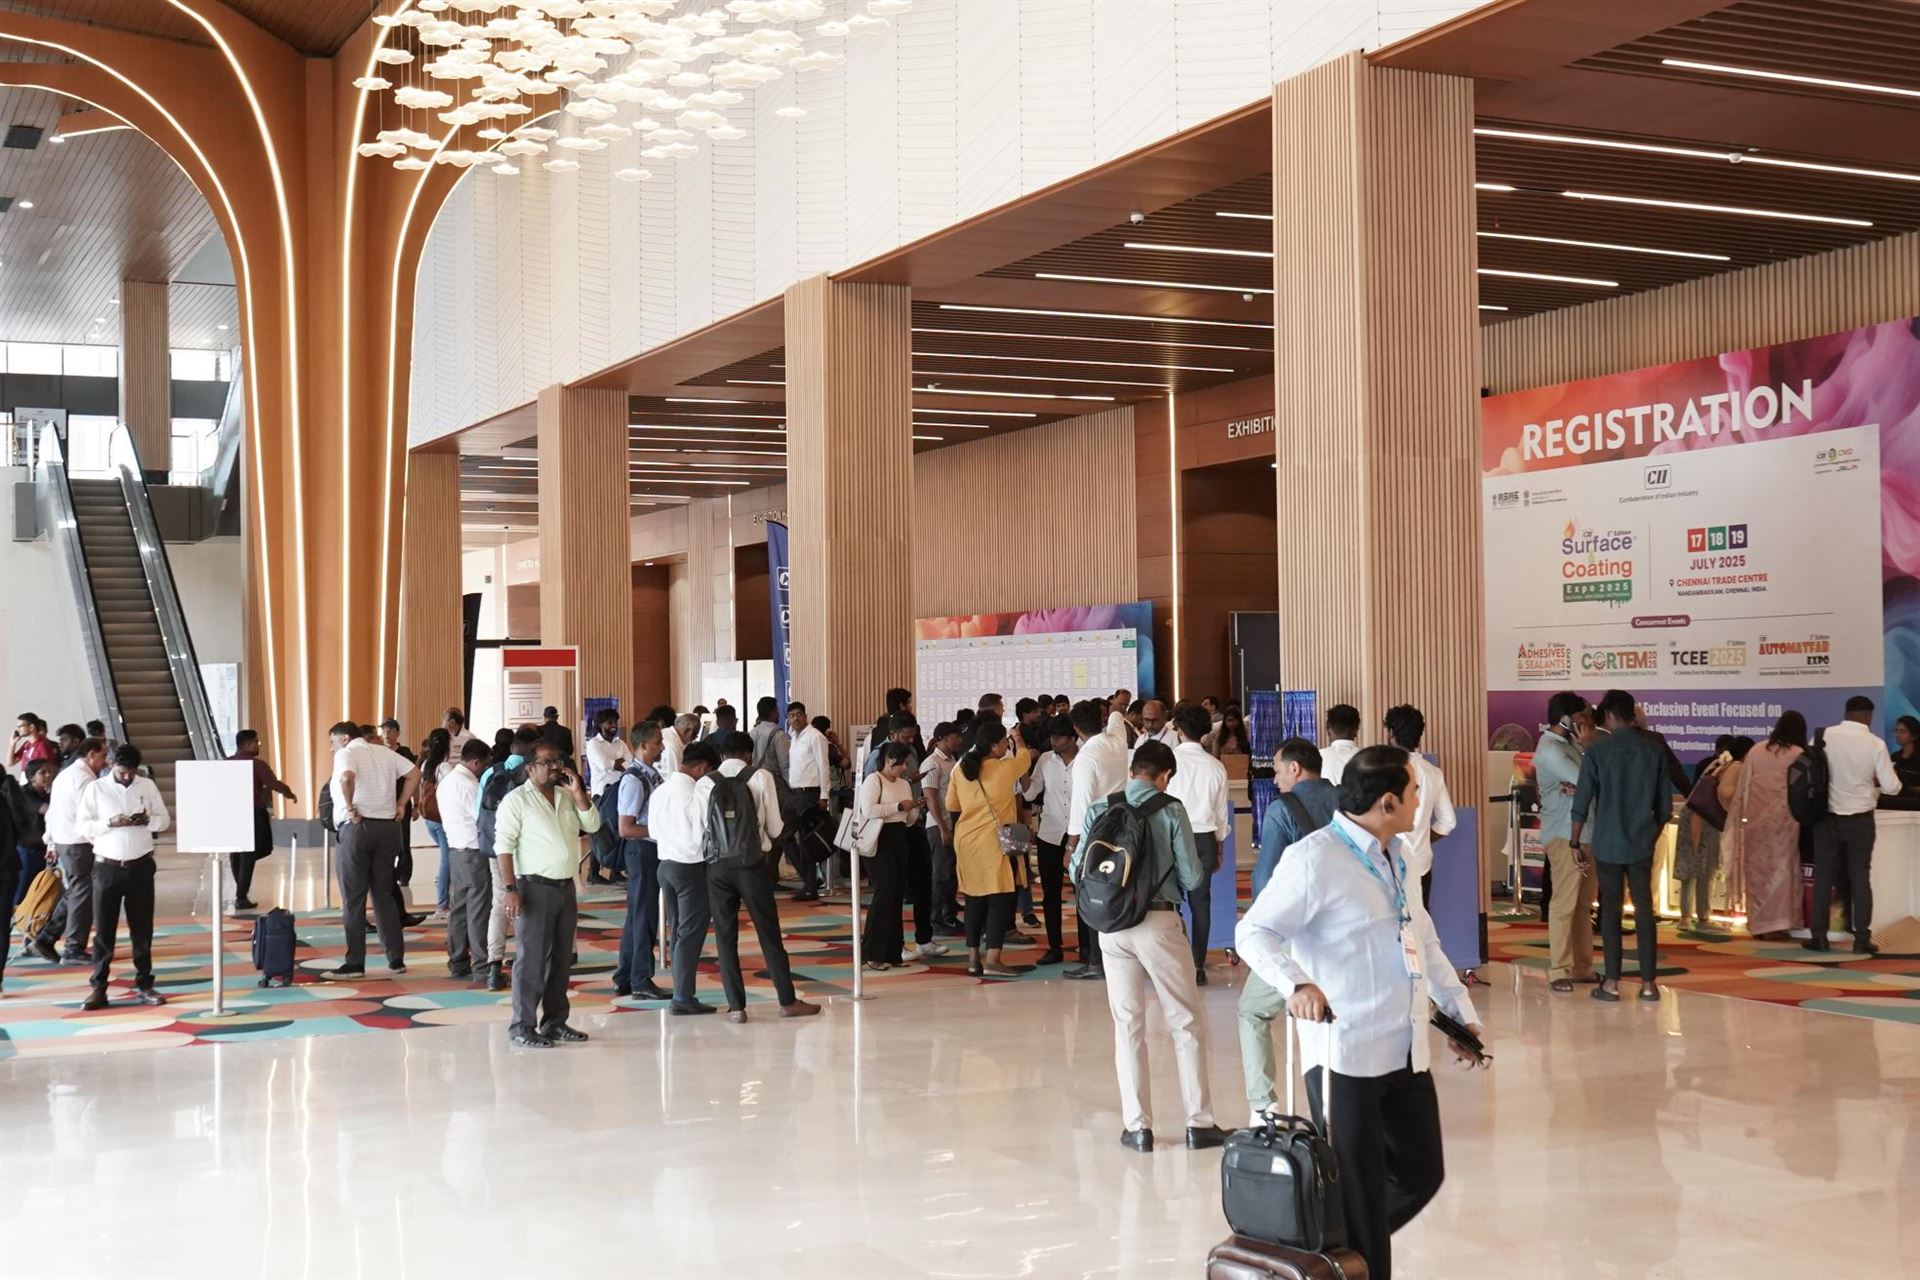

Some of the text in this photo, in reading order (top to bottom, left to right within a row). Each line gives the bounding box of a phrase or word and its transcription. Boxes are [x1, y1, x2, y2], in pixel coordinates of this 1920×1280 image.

[1227, 415, 1277, 438] EXHIBITI
[1523, 379, 1812, 461] REGISTRATION
[1647, 469, 1668, 485] CII
[1562, 535, 1633, 555] Surface
[1690, 530, 1745, 548] 17 18 19
[1562, 559, 1633, 578] Coating
[1689, 555, 1746, 570] JULY 2025
[1676, 573, 1768, 587] CHENNAI TRADE CENTRE
[1566, 582, 1629, 595] Expo 2025
[1635, 617, 1687, 627] Concurrent Events
[1518, 642, 1566, 659] ADHESIVES
[1670, 650, 1709, 666] TCEE
[1711, 648, 1744, 666] 2025
[1525, 659, 1566, 670] SEALANTS
[1581, 650, 1648, 670] CORTEM
[1807, 655, 1830, 665] EXPO
[1544, 669, 1566, 677] SUMMIT
[1643, 702, 1783, 718] Exclusive Event Focused on
[1732, 725, 1766, 736] Corrosion
[1672, 740, 1712, 751] Regulations
